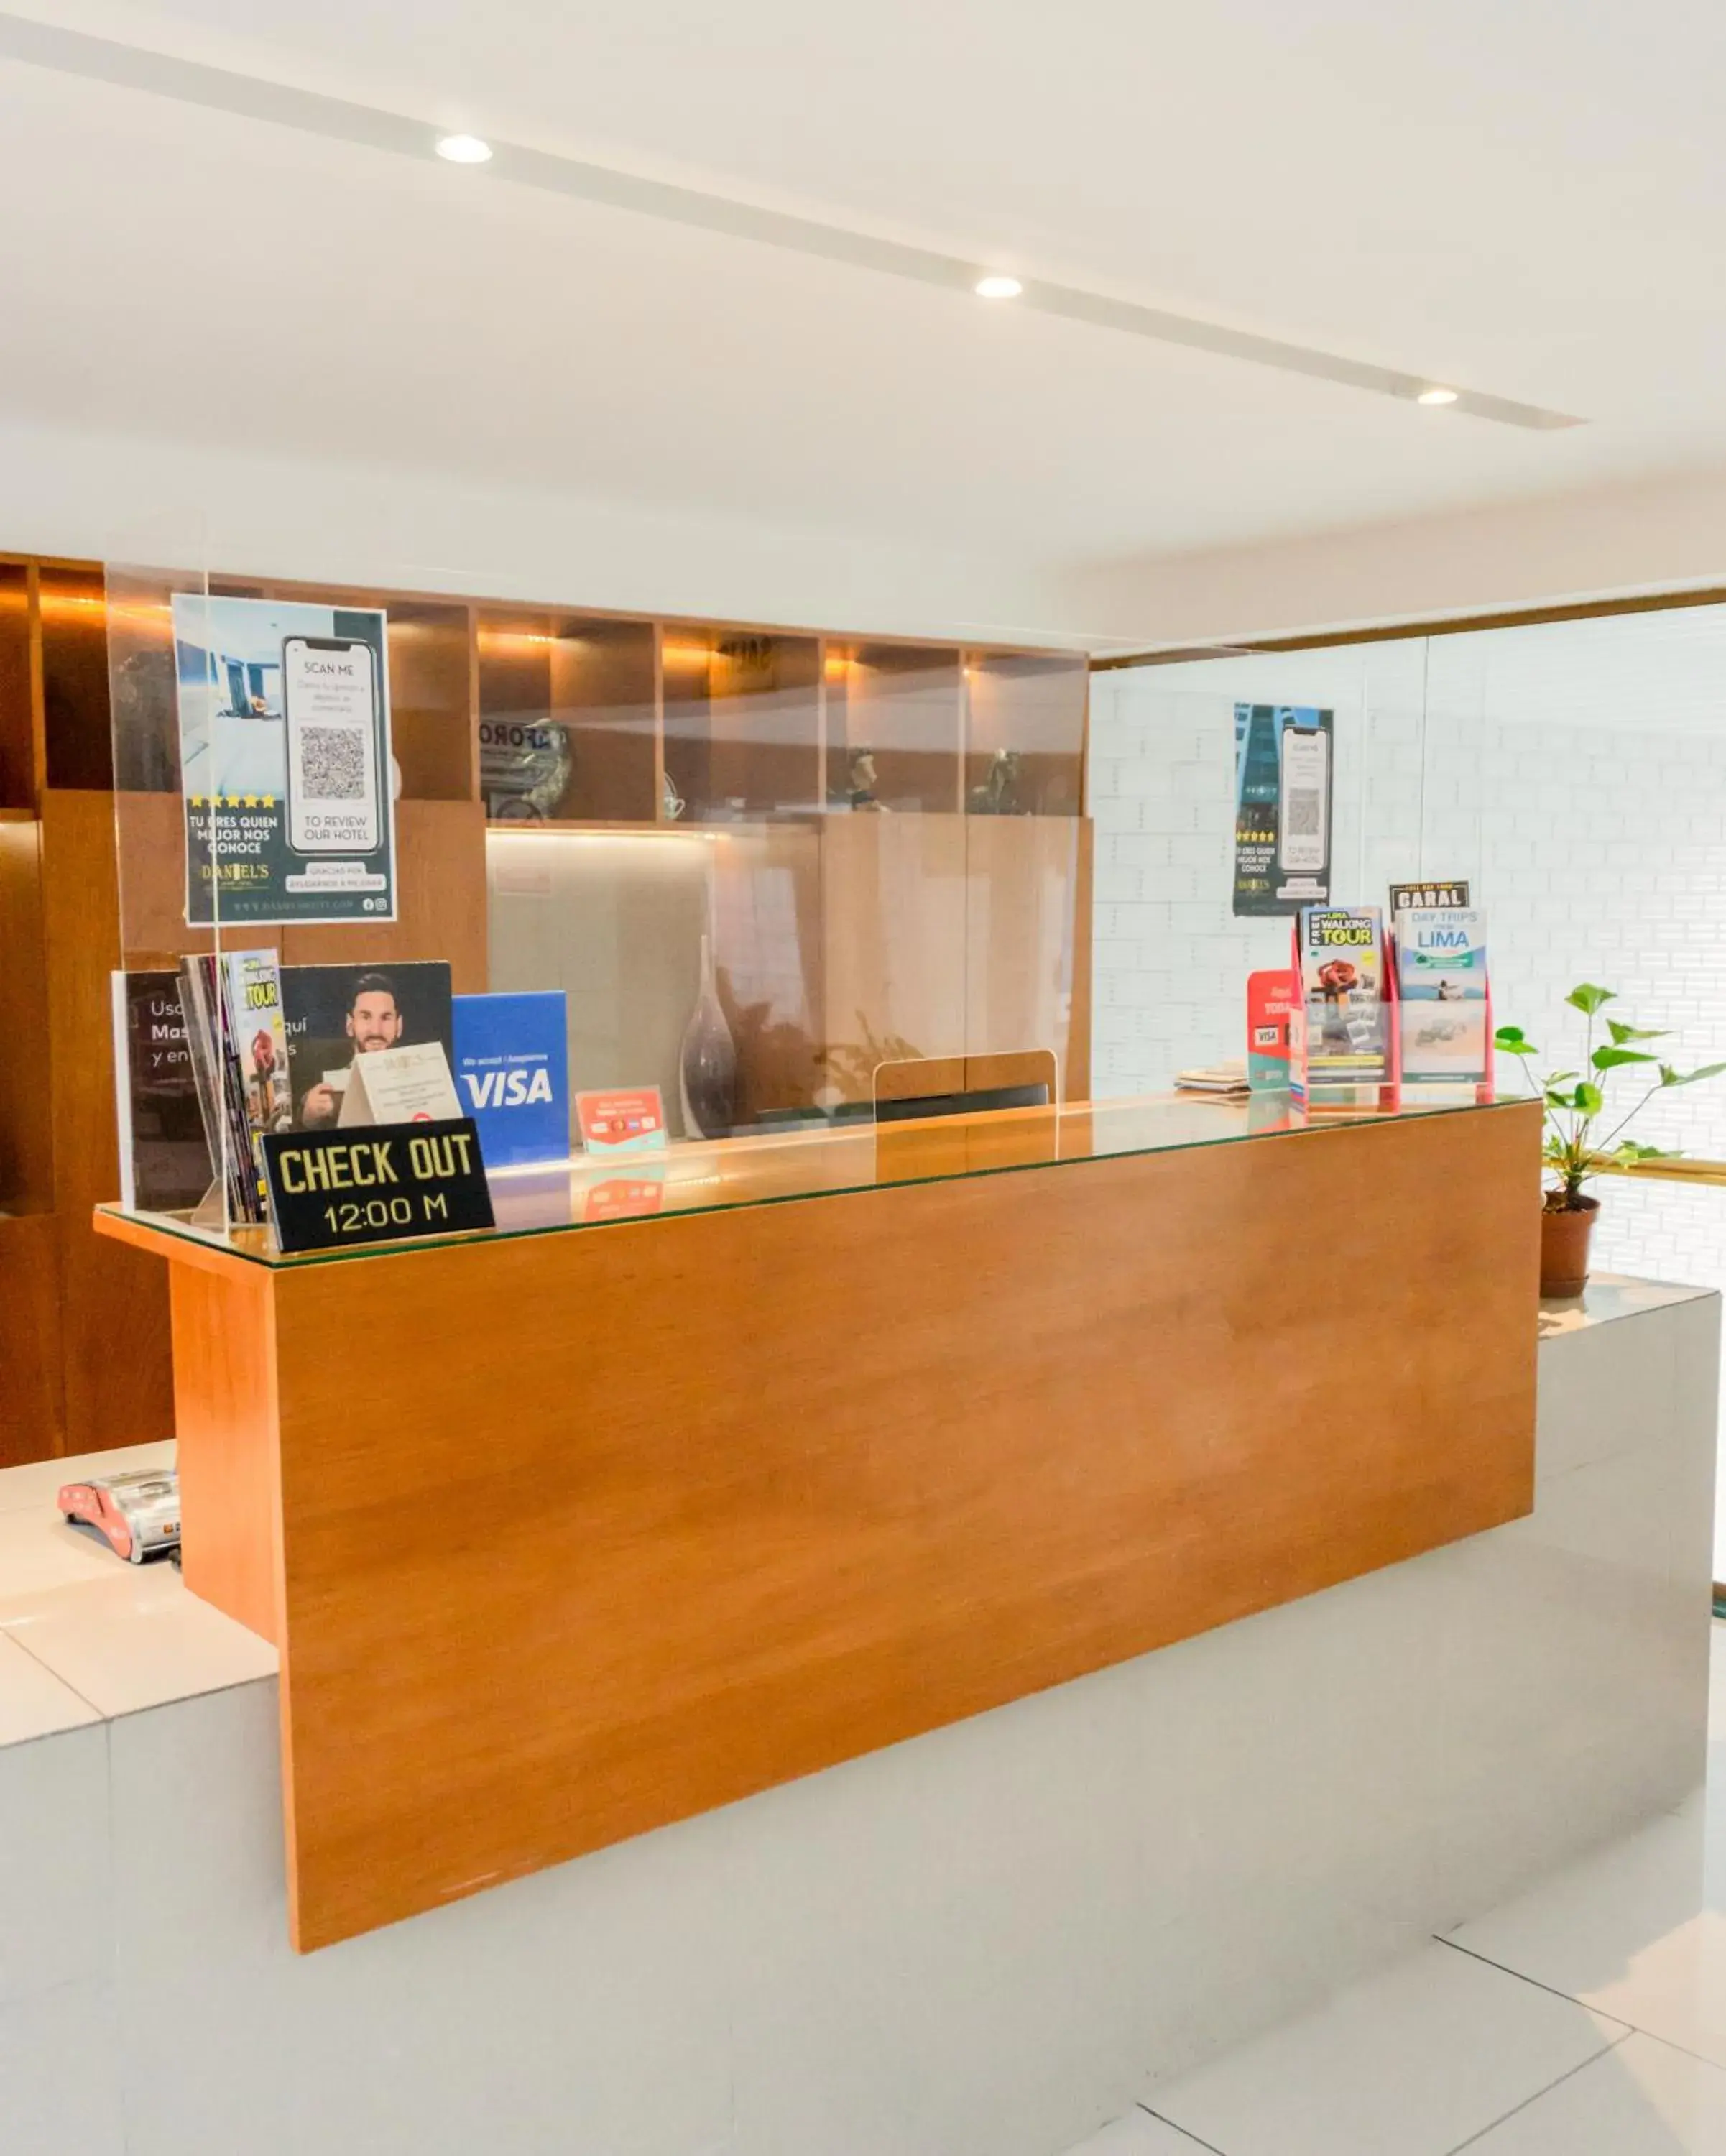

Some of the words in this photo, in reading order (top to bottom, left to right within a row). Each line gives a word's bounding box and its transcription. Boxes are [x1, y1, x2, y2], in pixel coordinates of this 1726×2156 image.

[304, 661, 334, 675] SCAN
[338, 665, 354, 676] ME
[189, 816, 204, 827] TU
[240, 816, 277, 828] QUIEN
[305, 816, 320, 827] TO
[324, 816, 367, 827] REVIEW
[198, 829, 241, 841] MEJOR
[244, 830, 270, 841] NOS
[305, 830, 330, 840] OUR
[334, 830, 368, 840] HOTEL
[207, 842, 261, 854] CONOCE
[1398, 890, 1462, 907] CARAL
[1321, 919, 1371, 929] WALKING
[1412, 912, 1436, 921] DAY
[1440, 911, 1478, 922] TRIPS
[1322, 929, 1371, 944] TOUR
[1418, 931, 1469, 947] LIMA
[246, 982, 277, 1008] TOUR
[284, 1017, 307, 1035] quí
[1258, 1030, 1276, 1041] VISA
[152, 1052, 162, 1067] y
[460, 1069, 553, 1108] VISA
[279, 1141, 399, 1194] CHECK
[409, 1134, 471, 1179] OUT
[324, 1197, 412, 1233] 12:00
[423, 1192, 448, 1221] M
